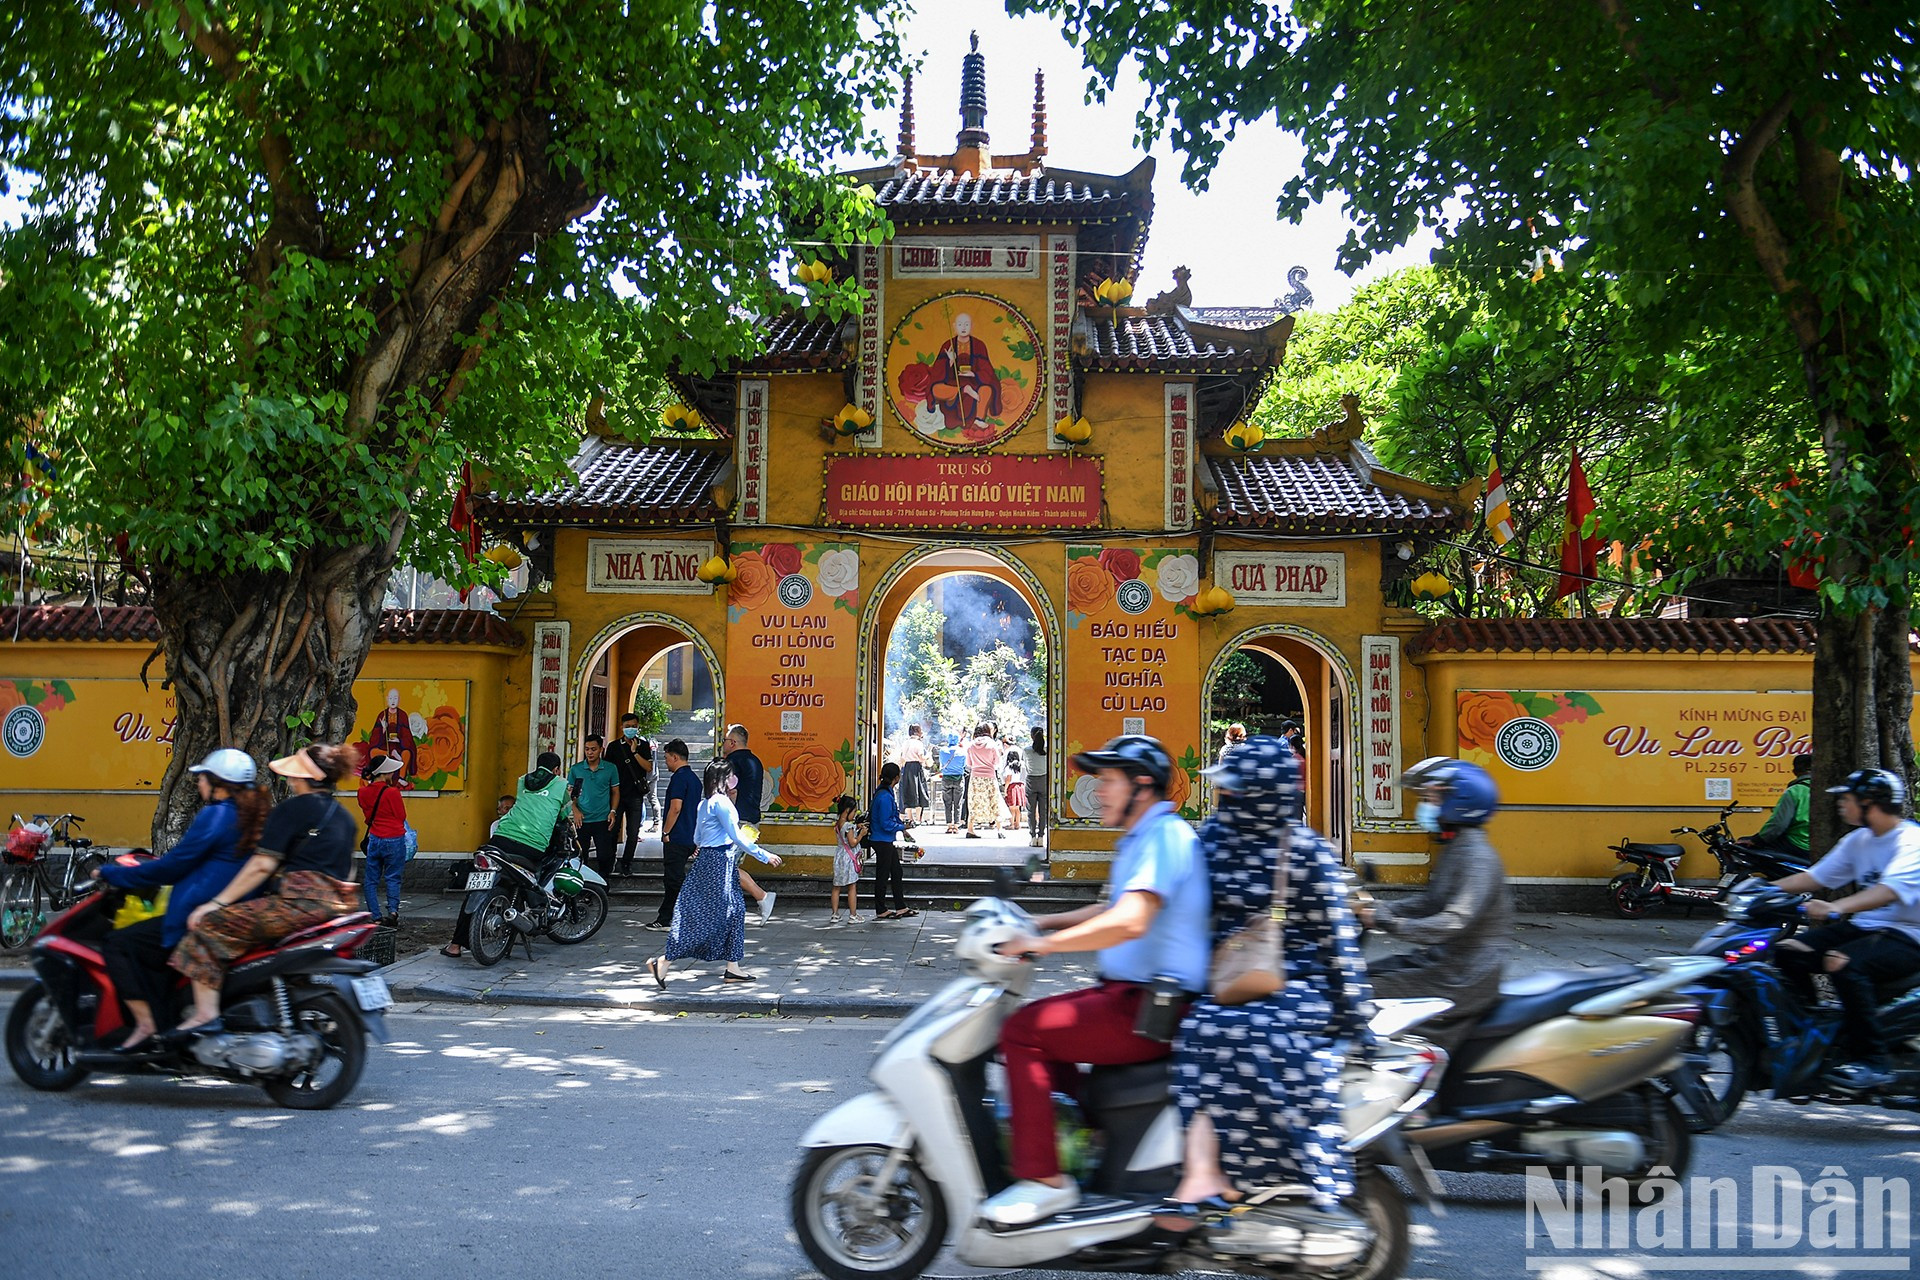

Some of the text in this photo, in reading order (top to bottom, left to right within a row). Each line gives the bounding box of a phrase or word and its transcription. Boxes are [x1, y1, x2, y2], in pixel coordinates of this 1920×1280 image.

[937, 460, 992, 478] TRỤ SỞ
[841, 480, 1085, 506] GIÁO HỘI PHẬT GIÁO VIỆT NAM
[897, 508, 904, 516] 73
[651, 550, 699, 581] TĂNG
[1275, 565, 1328, 593] PHÁP
[761, 615, 828, 629] VU LAN
[1091, 618, 1178, 639] BÁO HIẾU
[752, 632, 836, 649] GHI LÒNG
[780, 654, 806, 668] ƠN
[1101, 647, 1168, 667] TẠC DẠ
[771, 674, 814, 688] SINH
[1105, 668, 1164, 687] NGHĨA
[165, 696, 177, 708] KÍ
[760, 690, 825, 708] DƯỠNG
[1101, 692, 1167, 712] CÙ LAO
[1679, 708, 1807, 724] KÍNH MỪNG ĐẠI
[114, 712, 152, 743] Vu
[1603, 725, 1662, 757] Vu
[1668, 726, 1745, 758] Lan
[1685, 762, 1748, 773] PL.2567
[1765, 762, 1791, 773] DL.
